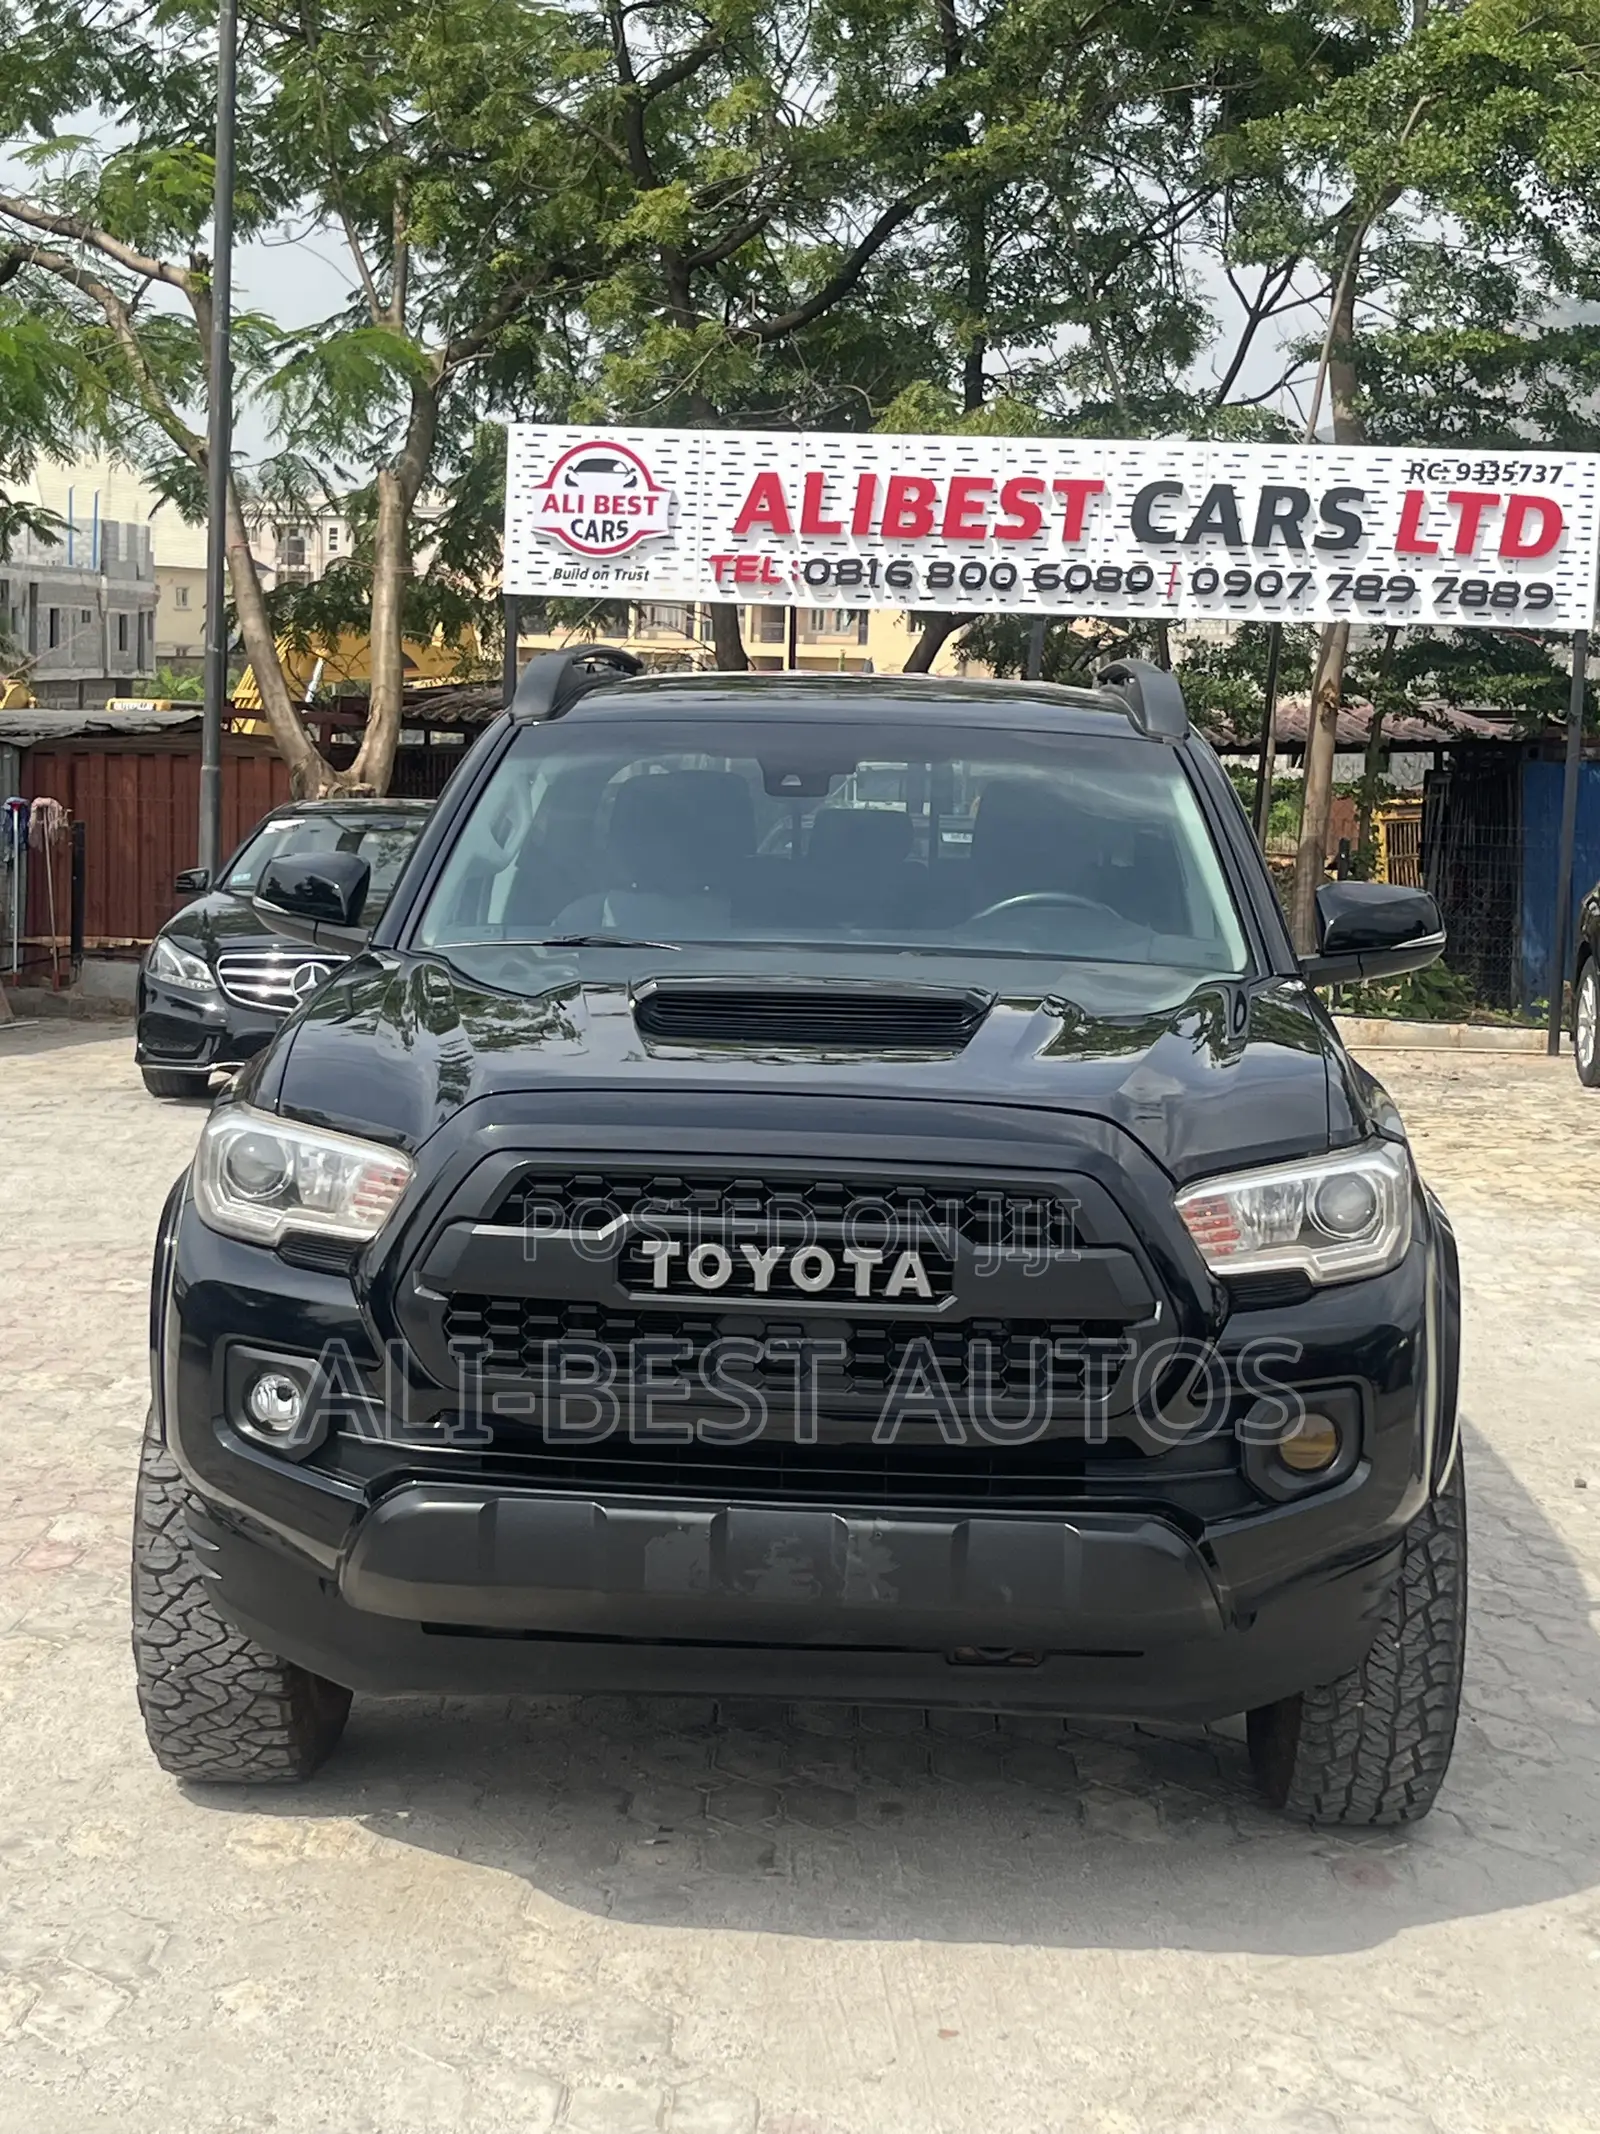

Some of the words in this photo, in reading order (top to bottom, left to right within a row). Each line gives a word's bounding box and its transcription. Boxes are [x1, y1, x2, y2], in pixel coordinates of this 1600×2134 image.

[1456, 462, 1563, 484] 9335737
[541, 493, 584, 514] ALI
[594, 495, 659, 515] BEST
[732, 471, 1105, 542] ALIBEST
[1129, 481, 1366, 550] CARS
[1394, 489, 1563, 558] LTD
[570, 518, 629, 543] CARS
[553, 568, 590, 581] Build
[592, 571, 609, 581] on
[615, 568, 650, 582] Trust
[804, 558, 913, 587] 0816
[927, 561, 1017, 591] 800
[1033, 563, 1154, 593] 6080
[1191, 567, 1312, 599] 0907
[1326, 573, 1415, 602] 789
[1432, 576, 1554, 610] 7889
[641, 1240, 932, 1297] TOYOTA
